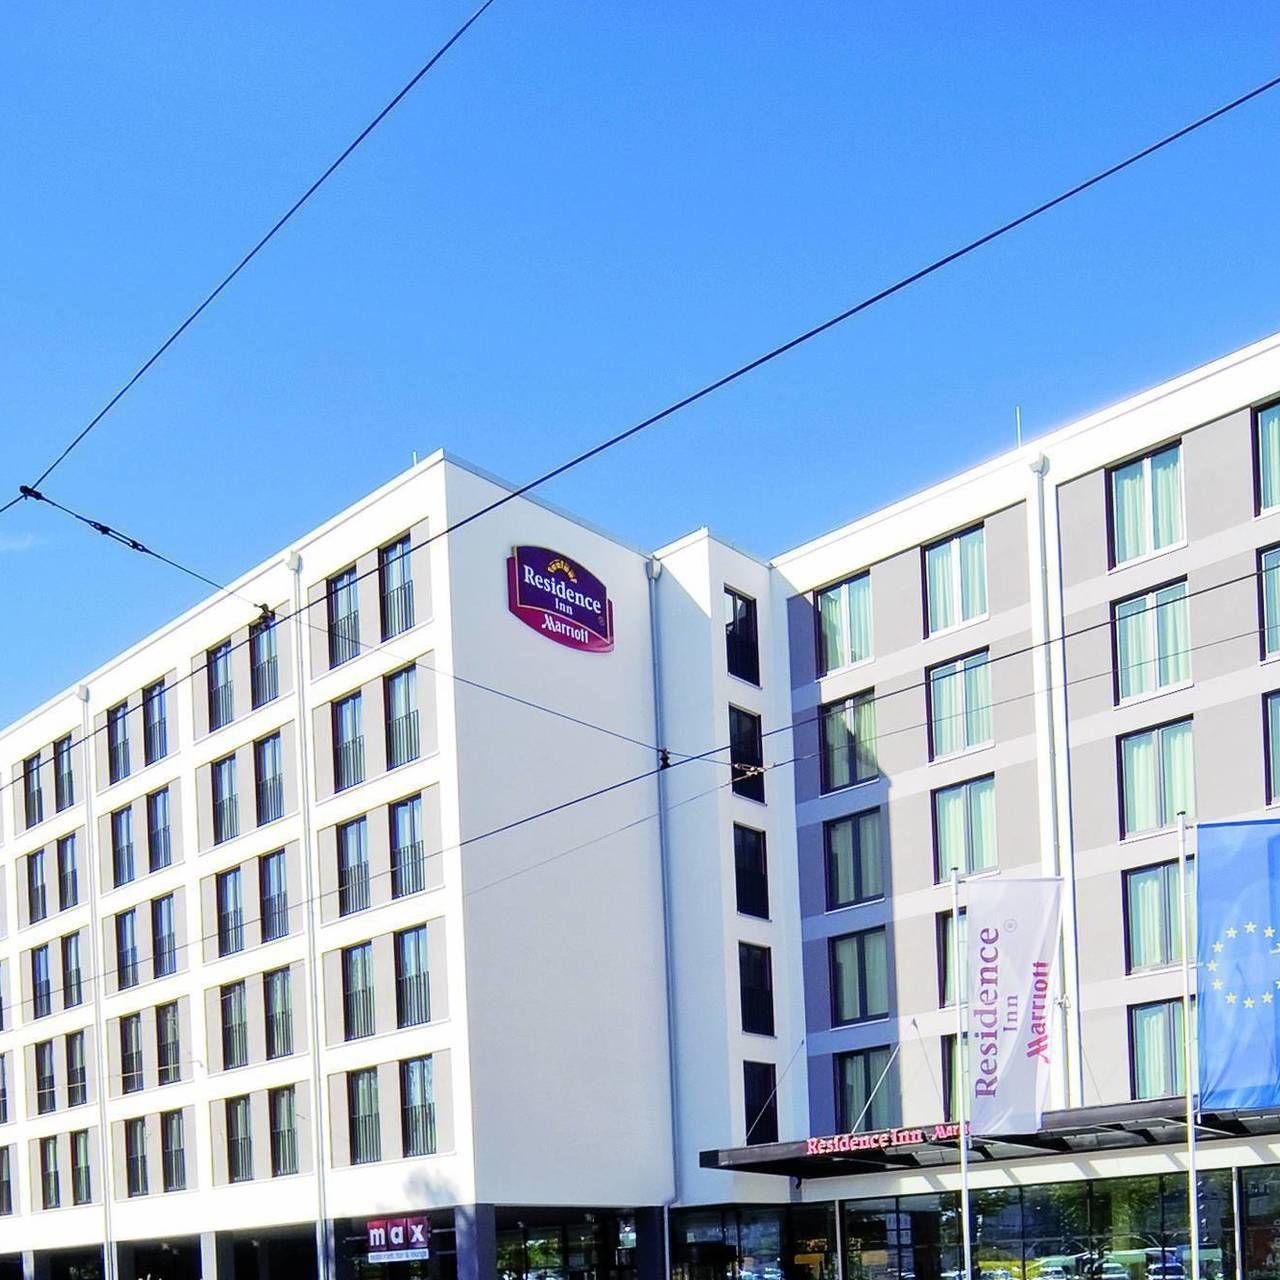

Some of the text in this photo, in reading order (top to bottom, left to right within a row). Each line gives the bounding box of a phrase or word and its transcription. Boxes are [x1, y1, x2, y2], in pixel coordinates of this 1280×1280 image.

[523, 564, 602, 614] Residence
[554, 597, 573, 615] Inn
[541, 613, 589, 643] Marriott
[974, 927, 1000, 1099] Residence
[1002, 994, 1019, 1033] Inn
[1026, 960, 1051, 1065] Marriott
[806, 1133, 890, 1155] Residence
[890, 1128, 923, 1145] Inn
[369, 1224, 425, 1246] max
